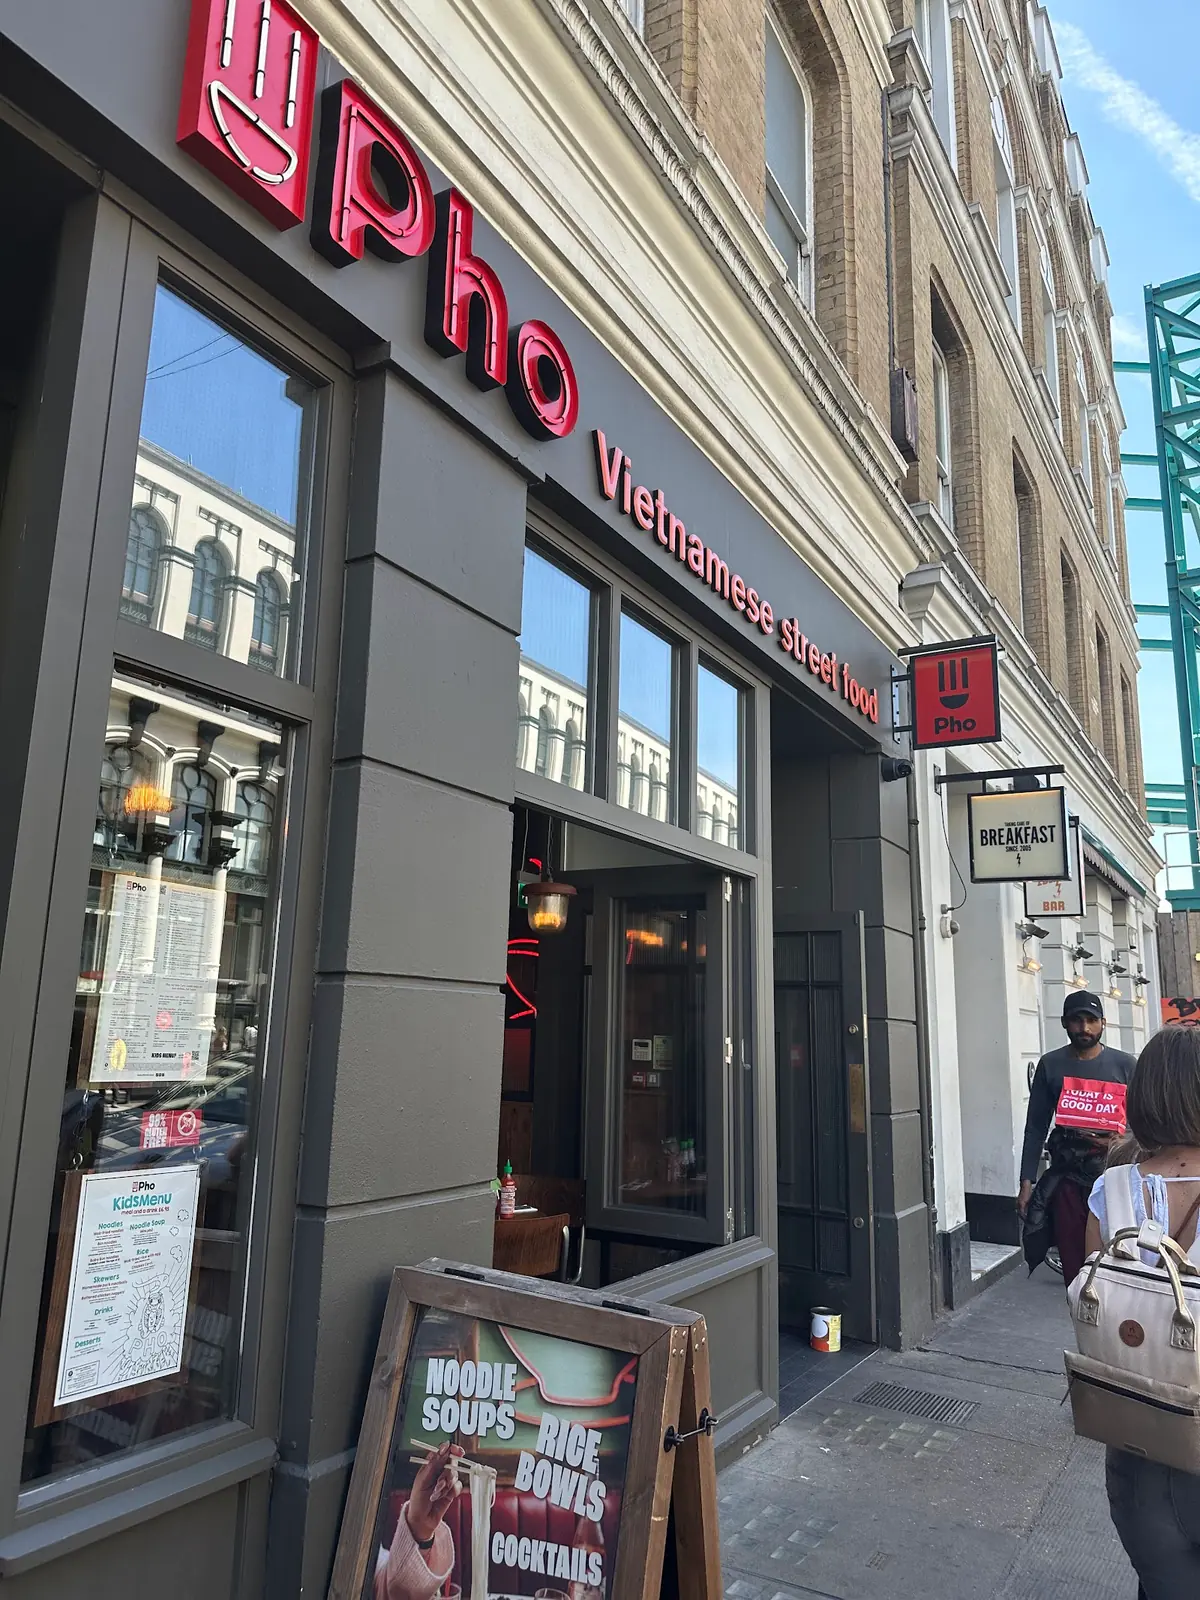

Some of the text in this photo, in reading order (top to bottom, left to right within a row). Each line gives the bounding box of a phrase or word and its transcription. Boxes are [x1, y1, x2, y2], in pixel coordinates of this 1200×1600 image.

[592, 429, 879, 724] Vietnamese street food
[934, 715, 976, 735] Pho
[980, 825, 1056, 846] BREAKFAST
[131, 882, 147, 892] Pho
[1043, 901, 1065, 911] BAR
[1061, 1098, 1118, 1114] GOOD DAY
[149, 1113, 167, 1127] 98%
[143, 1136, 167, 1148] FREE
[138, 1181, 155, 1191] Pho
[98, 1221, 123, 1230] Noodles
[129, 1222, 150, 1231] Noodle
[151, 1219, 166, 1227] Soup
[136, 1248, 149, 1256] Rice
[93, 1274, 120, 1284] Skewers
[94, 1305, 113, 1316] Drinks
[74, 1336, 101, 1349] Desserts
[128, 1331, 167, 1357] PHO
[426, 1358, 517, 1401] NOODLE
[422, 1397, 515, 1440] SOUPS
[536, 1412, 603, 1474] RICE
[514, 1451, 607, 1522] BOWLS
[491, 1531, 603, 1587] COCKTAILS
